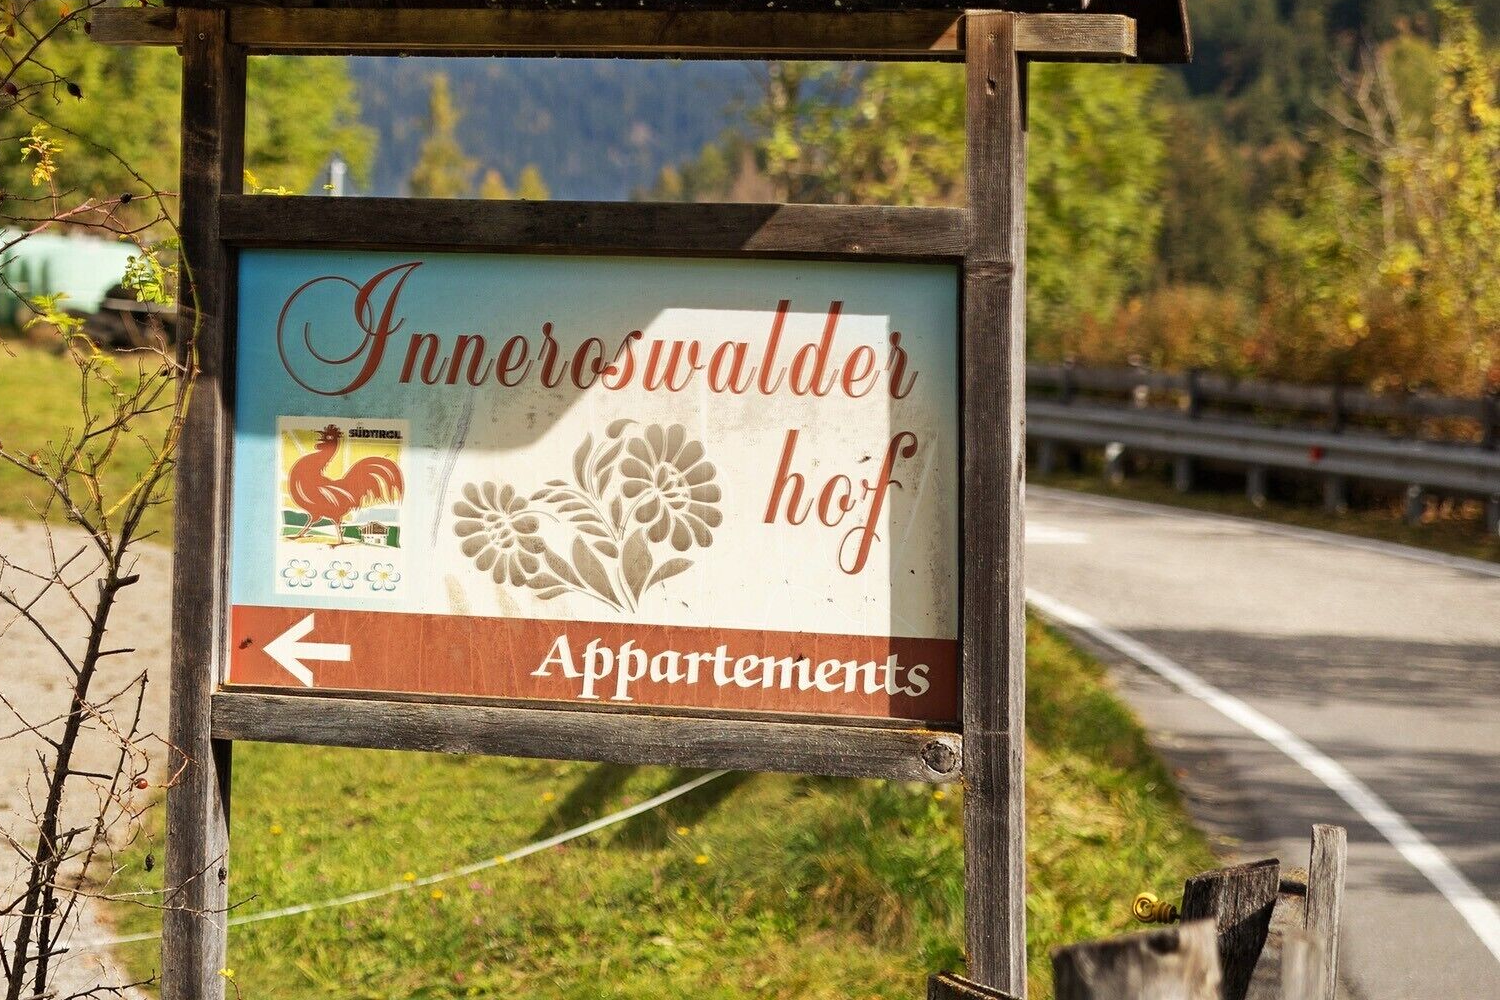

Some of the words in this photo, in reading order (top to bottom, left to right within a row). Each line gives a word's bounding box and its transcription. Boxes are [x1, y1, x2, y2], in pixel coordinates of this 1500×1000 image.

[276, 261, 918, 400] Inneroswalder
[763, 429, 918, 575] hof
[530, 633, 930, 699] Appartements
